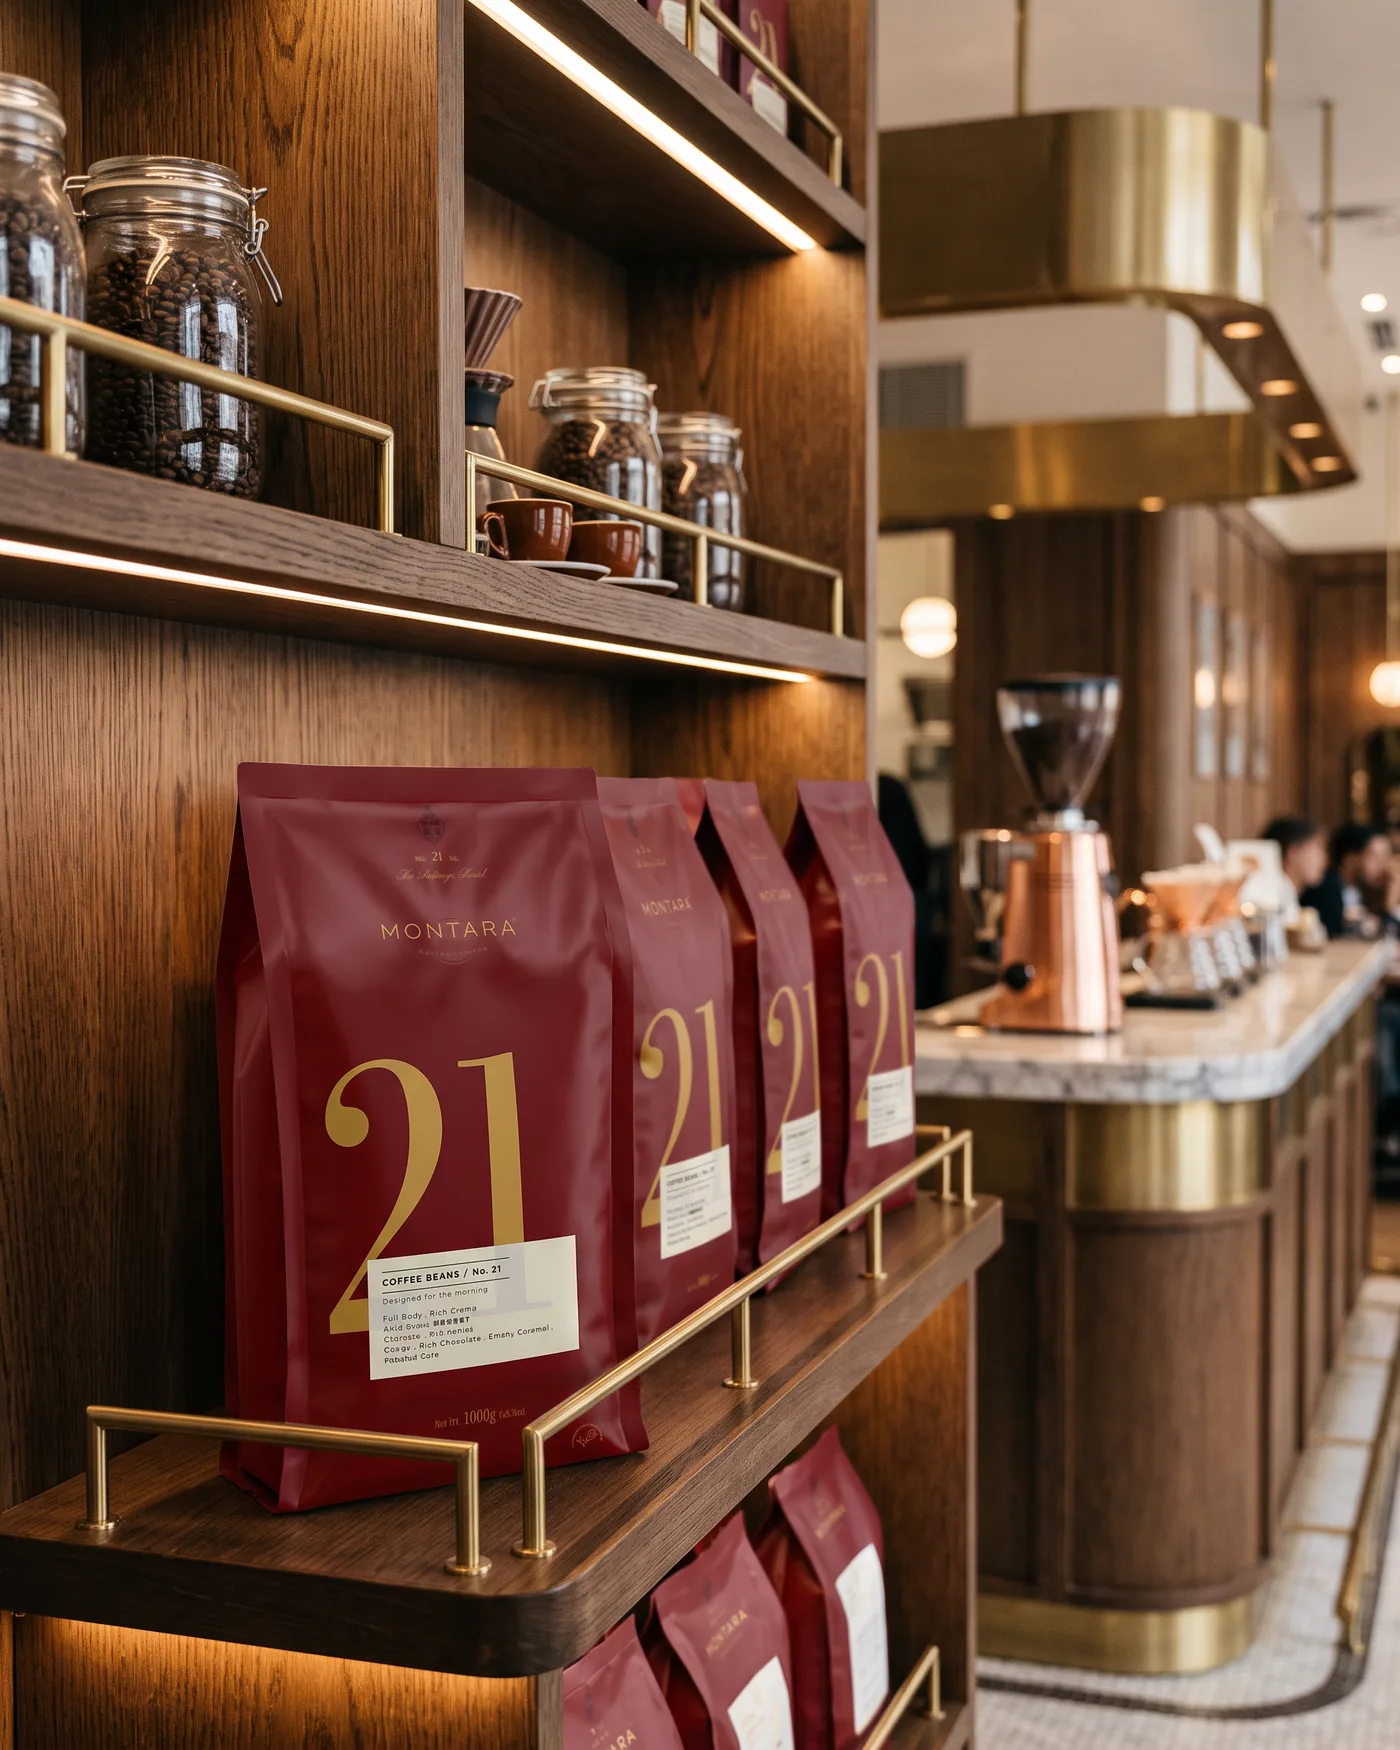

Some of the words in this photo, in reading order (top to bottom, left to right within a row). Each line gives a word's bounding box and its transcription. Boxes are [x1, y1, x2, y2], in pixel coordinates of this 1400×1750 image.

[431, 851, 443, 862] 21
[641, 898, 693, 916] MONTARA
[381, 920, 516, 940] MONTARA
[855, 950, 909, 1121] 21
[766, 981, 820, 1175] 21
[639, 999, 722, 1228] 21
[325, 1052, 527, 1334] 21
[382, 1275, 423, 1287] COFFEE
[426, 1270, 460, 1282] BEANS
[472, 1266, 489, 1276] No.
[491, 1264, 502, 1274] 21
[382, 1294, 422, 1307] Designed
[424, 1292, 436, 1301] for
[439, 1290, 452, 1299] the
[454, 1286, 488, 1296] morning
[383, 1314, 399, 1323] Full
[401, 1311, 423, 1322] Body
[429, 1309, 448, 1318] Rich
[450, 1305, 477, 1315] Crema
[419, 1340, 438, 1350] Rich
[463, 1408, 497, 1425] 1000g
